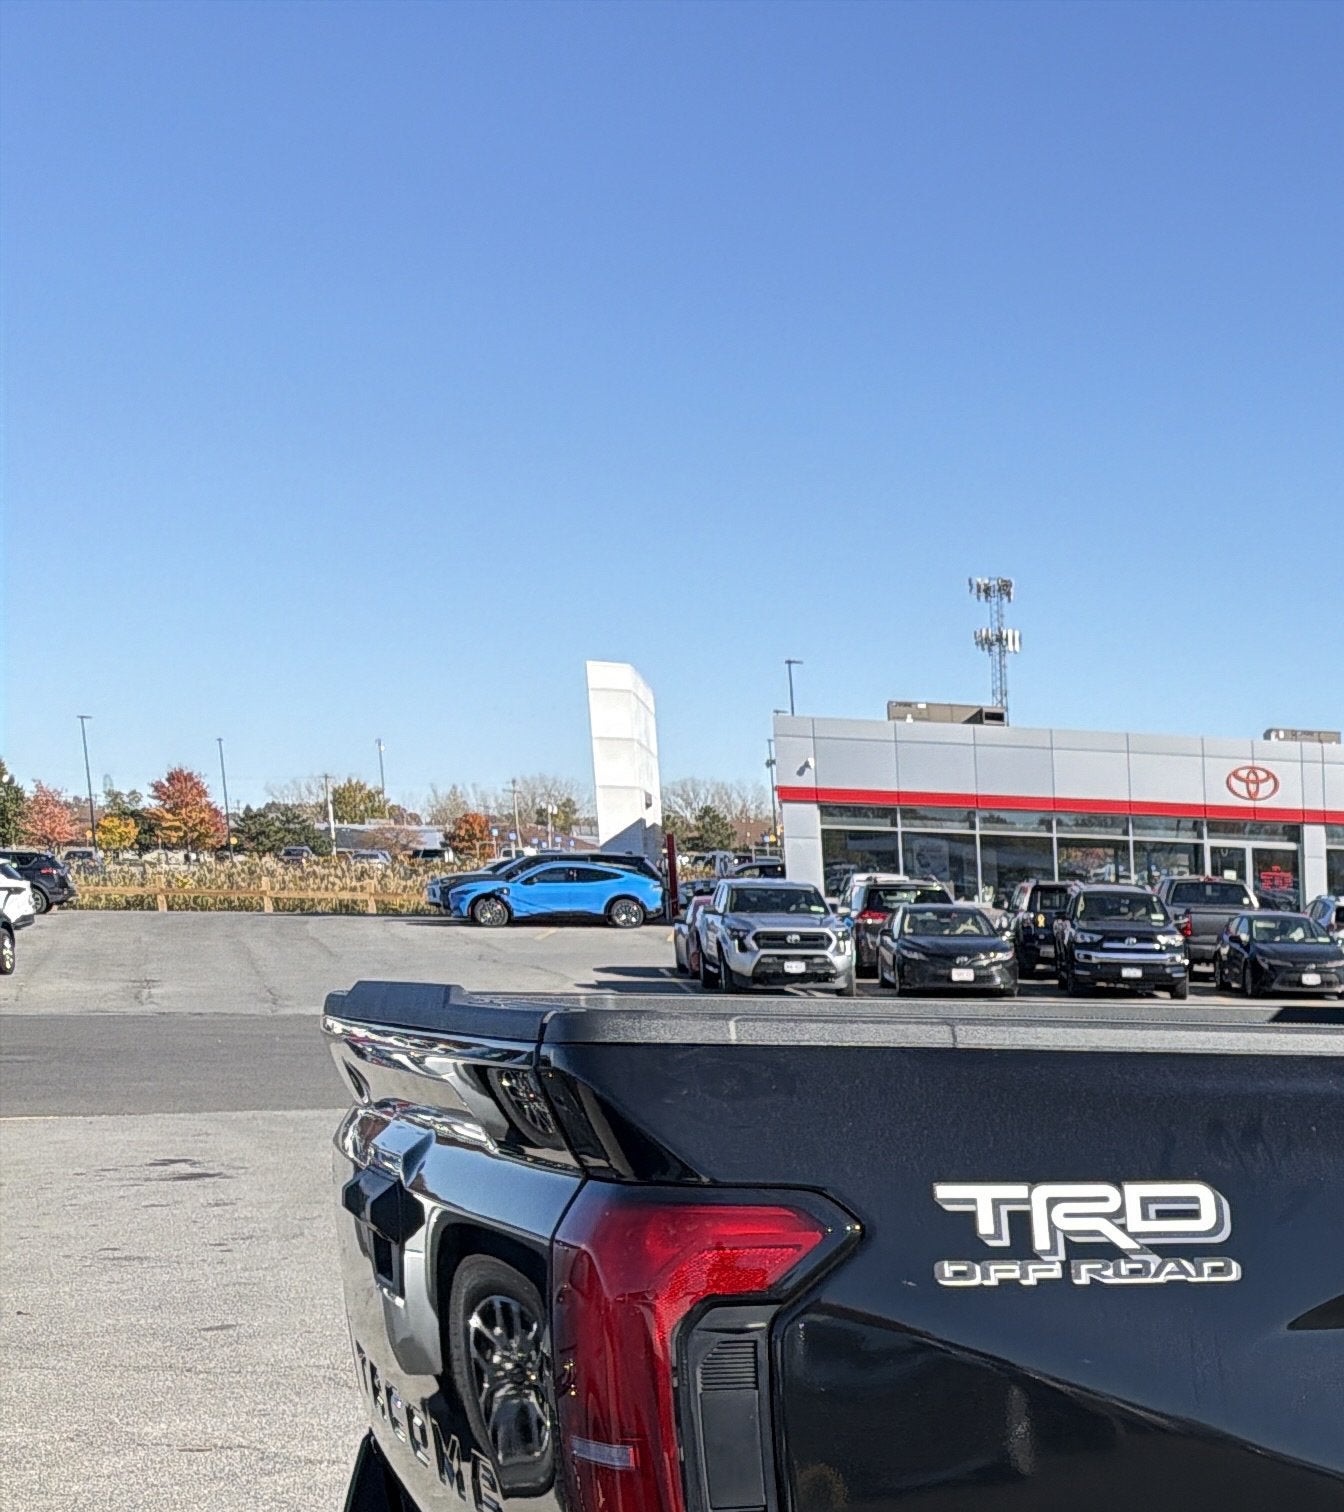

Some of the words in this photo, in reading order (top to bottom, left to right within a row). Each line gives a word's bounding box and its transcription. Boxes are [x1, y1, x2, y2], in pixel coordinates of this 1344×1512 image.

[933, 1181, 1232, 1261] TRD
[934, 1260, 1063, 1286] OFF
[1070, 1257, 1242, 1286] ROAD
